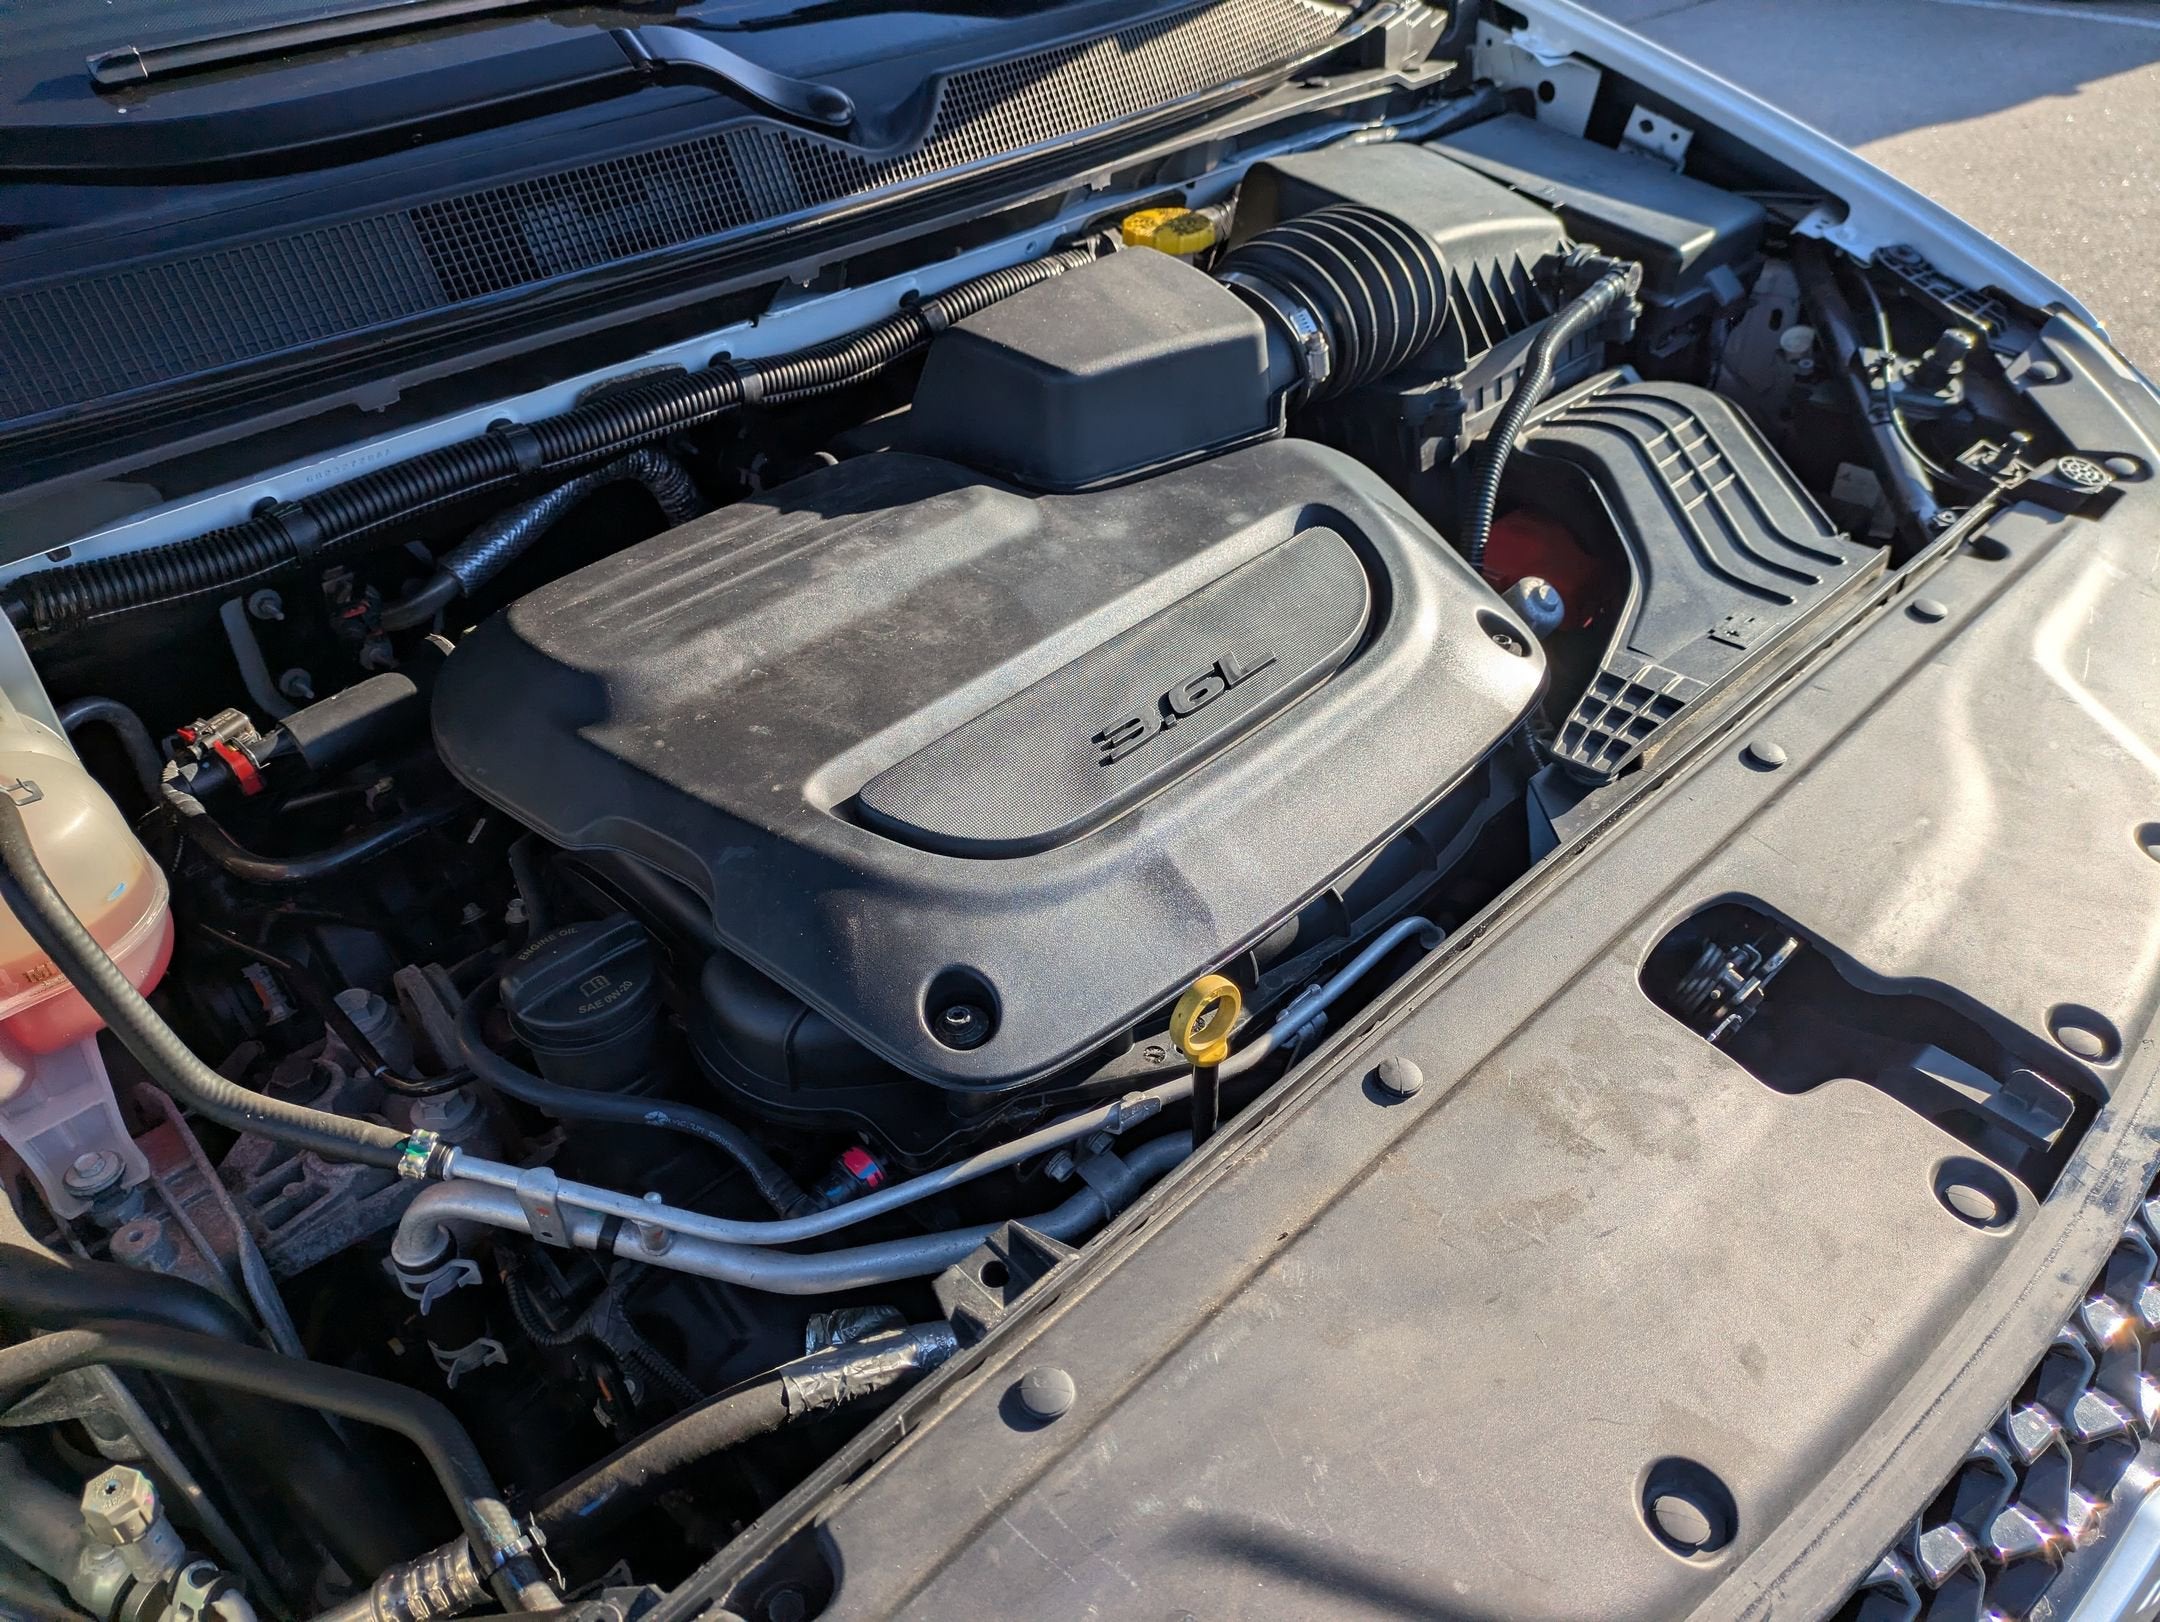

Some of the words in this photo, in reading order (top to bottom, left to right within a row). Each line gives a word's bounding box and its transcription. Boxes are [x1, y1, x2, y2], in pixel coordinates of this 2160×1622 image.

[1096, 650, 1277, 766] 3.6L
[518, 934, 557, 960] ENGINE
[559, 927, 578, 937] OIL
[578, 999, 604, 1014] SAE
[604, 980, 633, 1003] 0W-20
